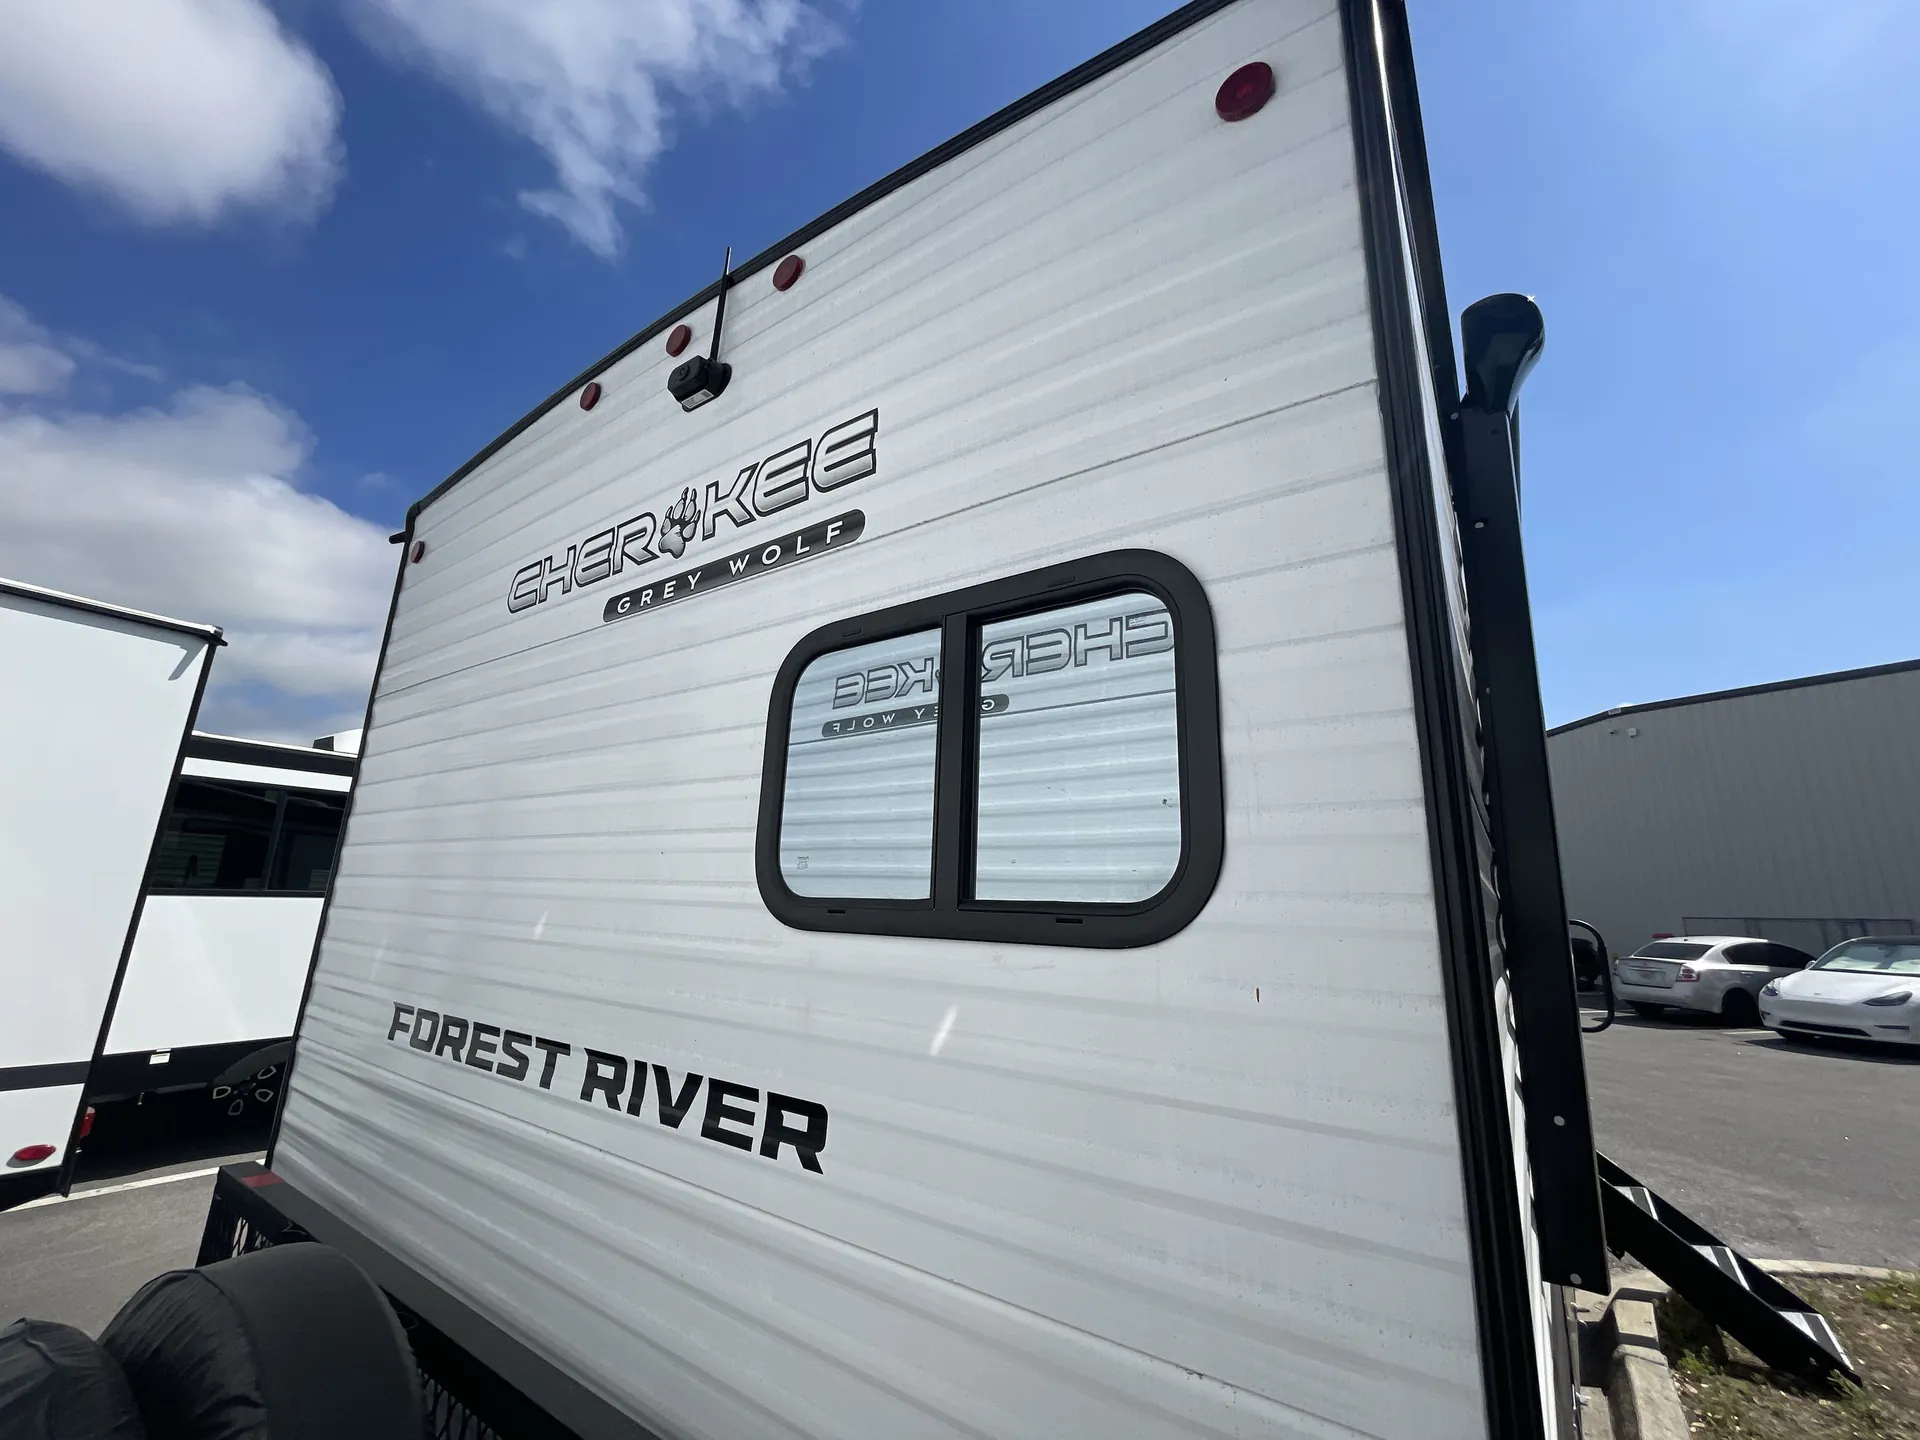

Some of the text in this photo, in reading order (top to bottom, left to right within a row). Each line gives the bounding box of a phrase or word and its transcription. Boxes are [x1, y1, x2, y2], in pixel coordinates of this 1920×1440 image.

[617, 519, 844, 614] GREY WOLF
[387, 1001, 829, 1175] FOREST RIVER
